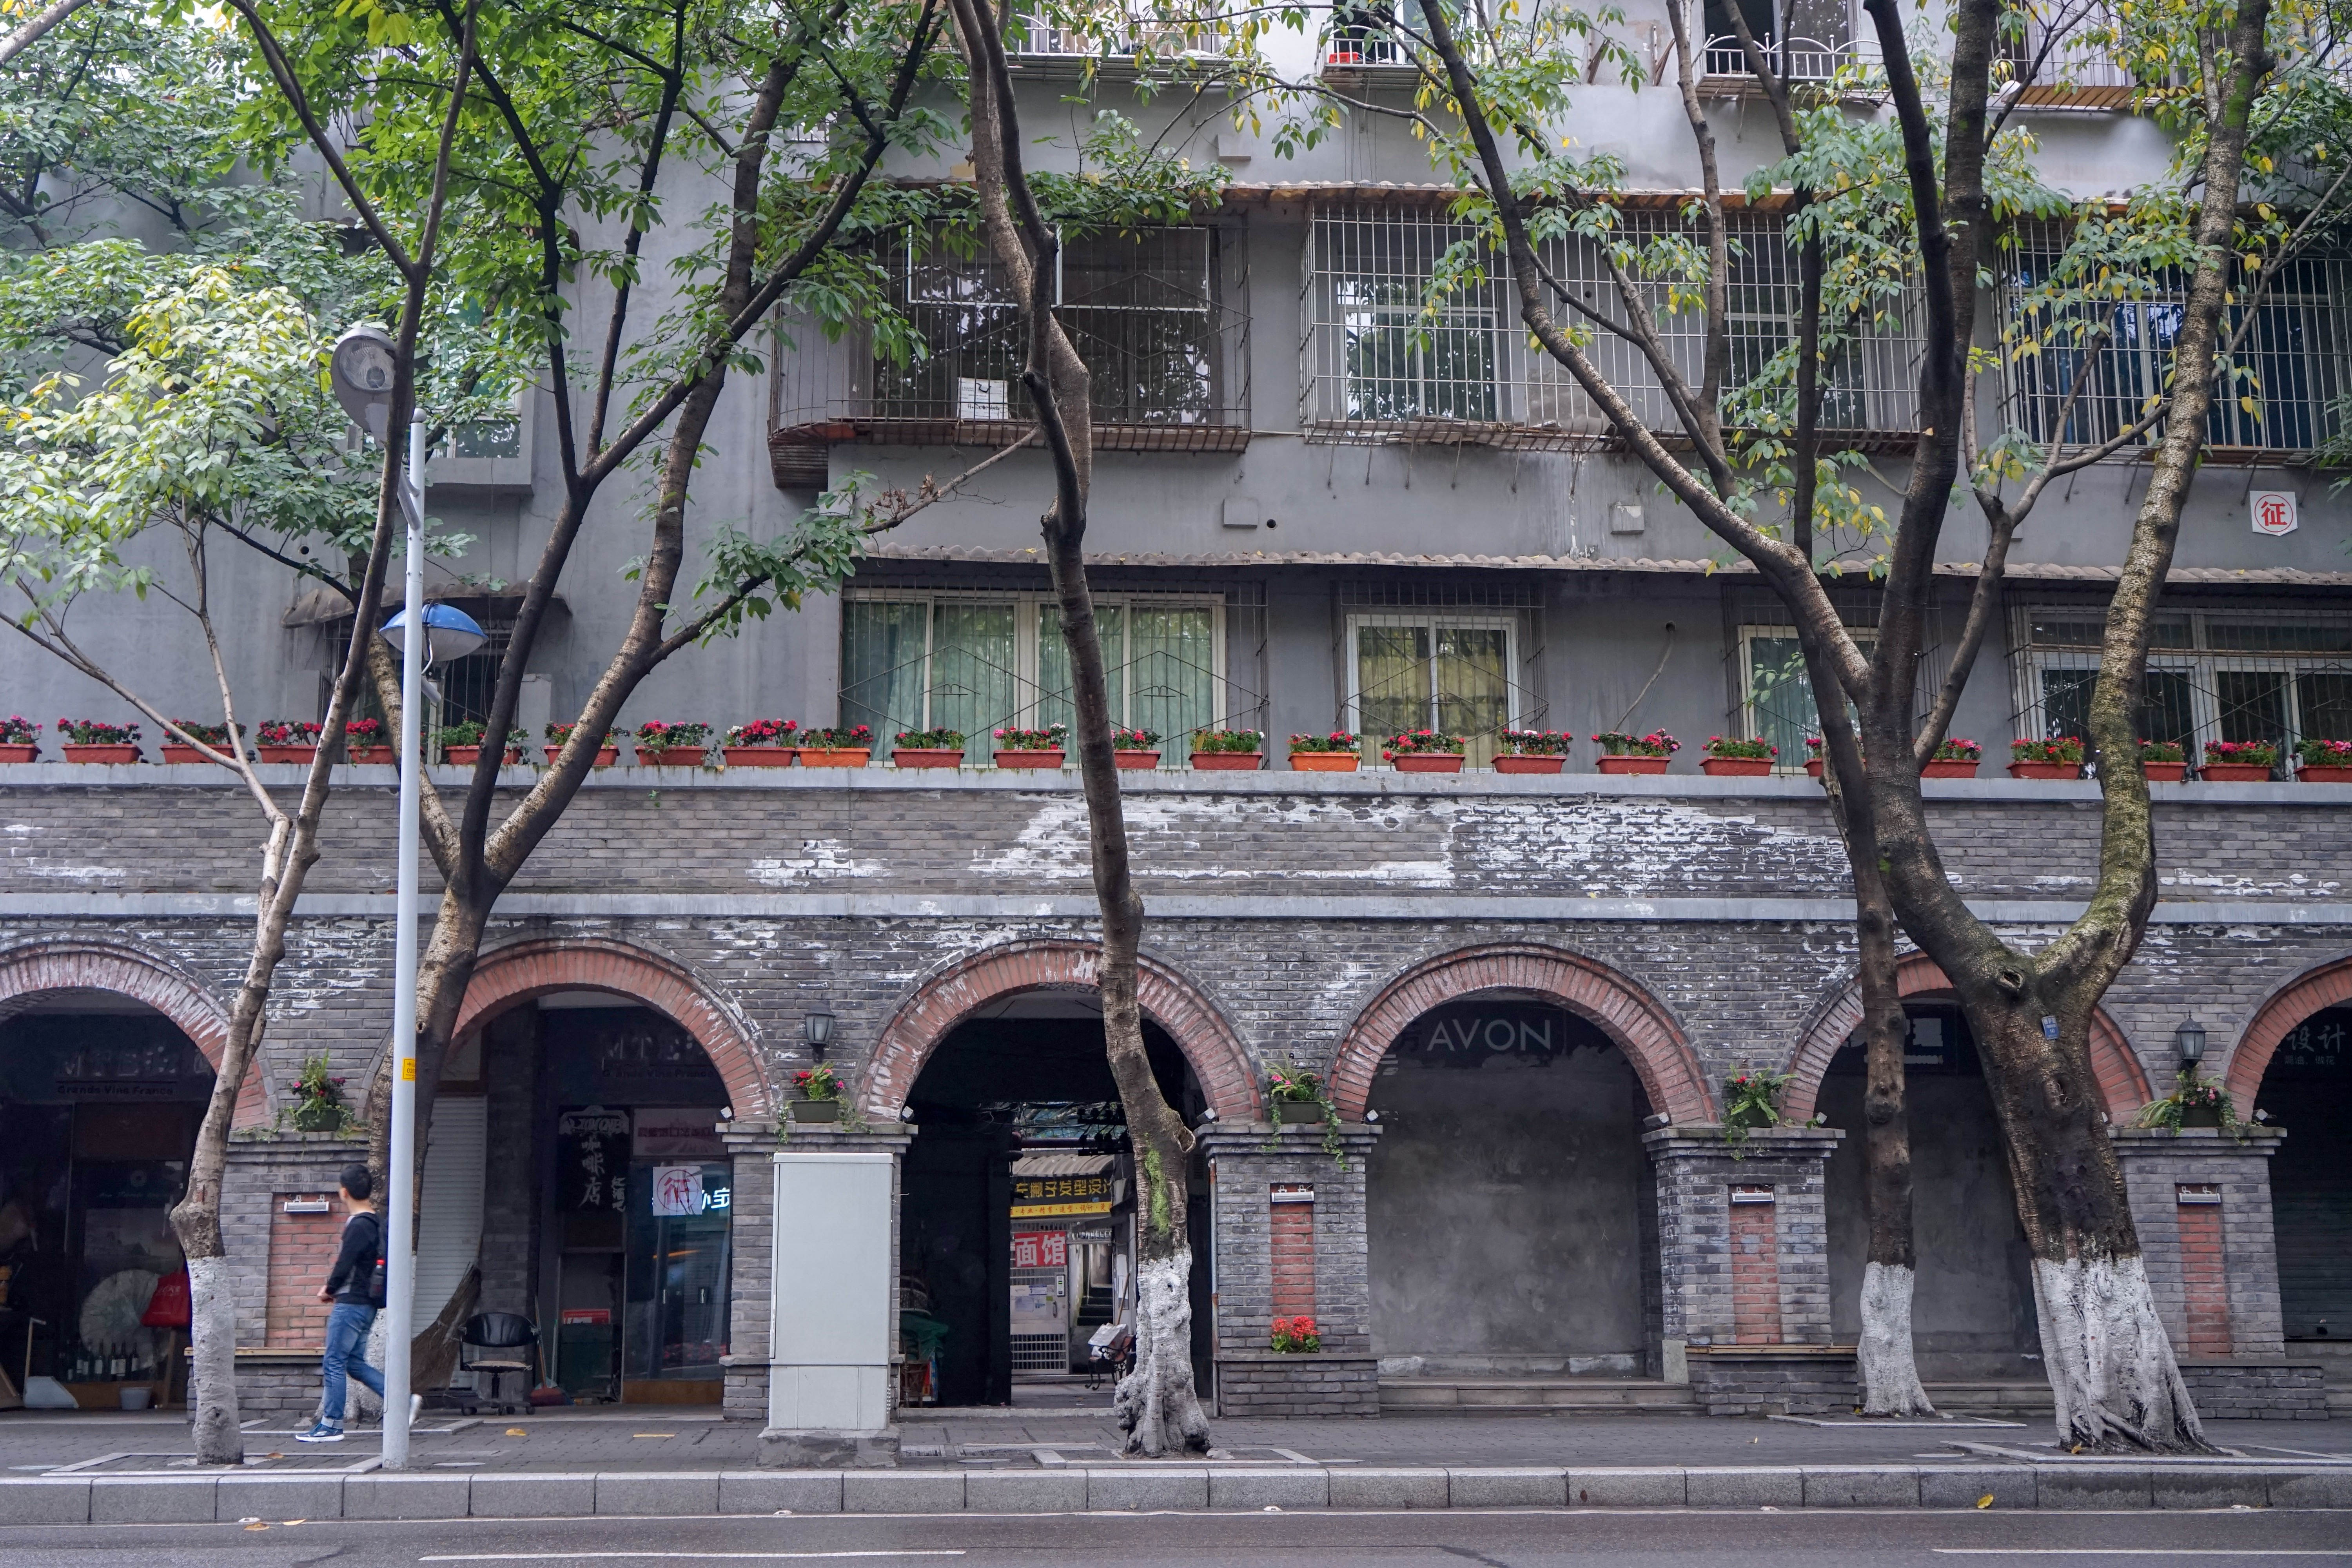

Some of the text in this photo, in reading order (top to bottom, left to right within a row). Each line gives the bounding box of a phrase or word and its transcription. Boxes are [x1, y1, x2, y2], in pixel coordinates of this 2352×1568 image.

[2261, 501, 2287, 526] 征
[1427, 1019, 1550, 1051] AVON
[2276, 1023, 2346, 1053] 设计
[1014, 1234, 1066, 1267] 面馆
